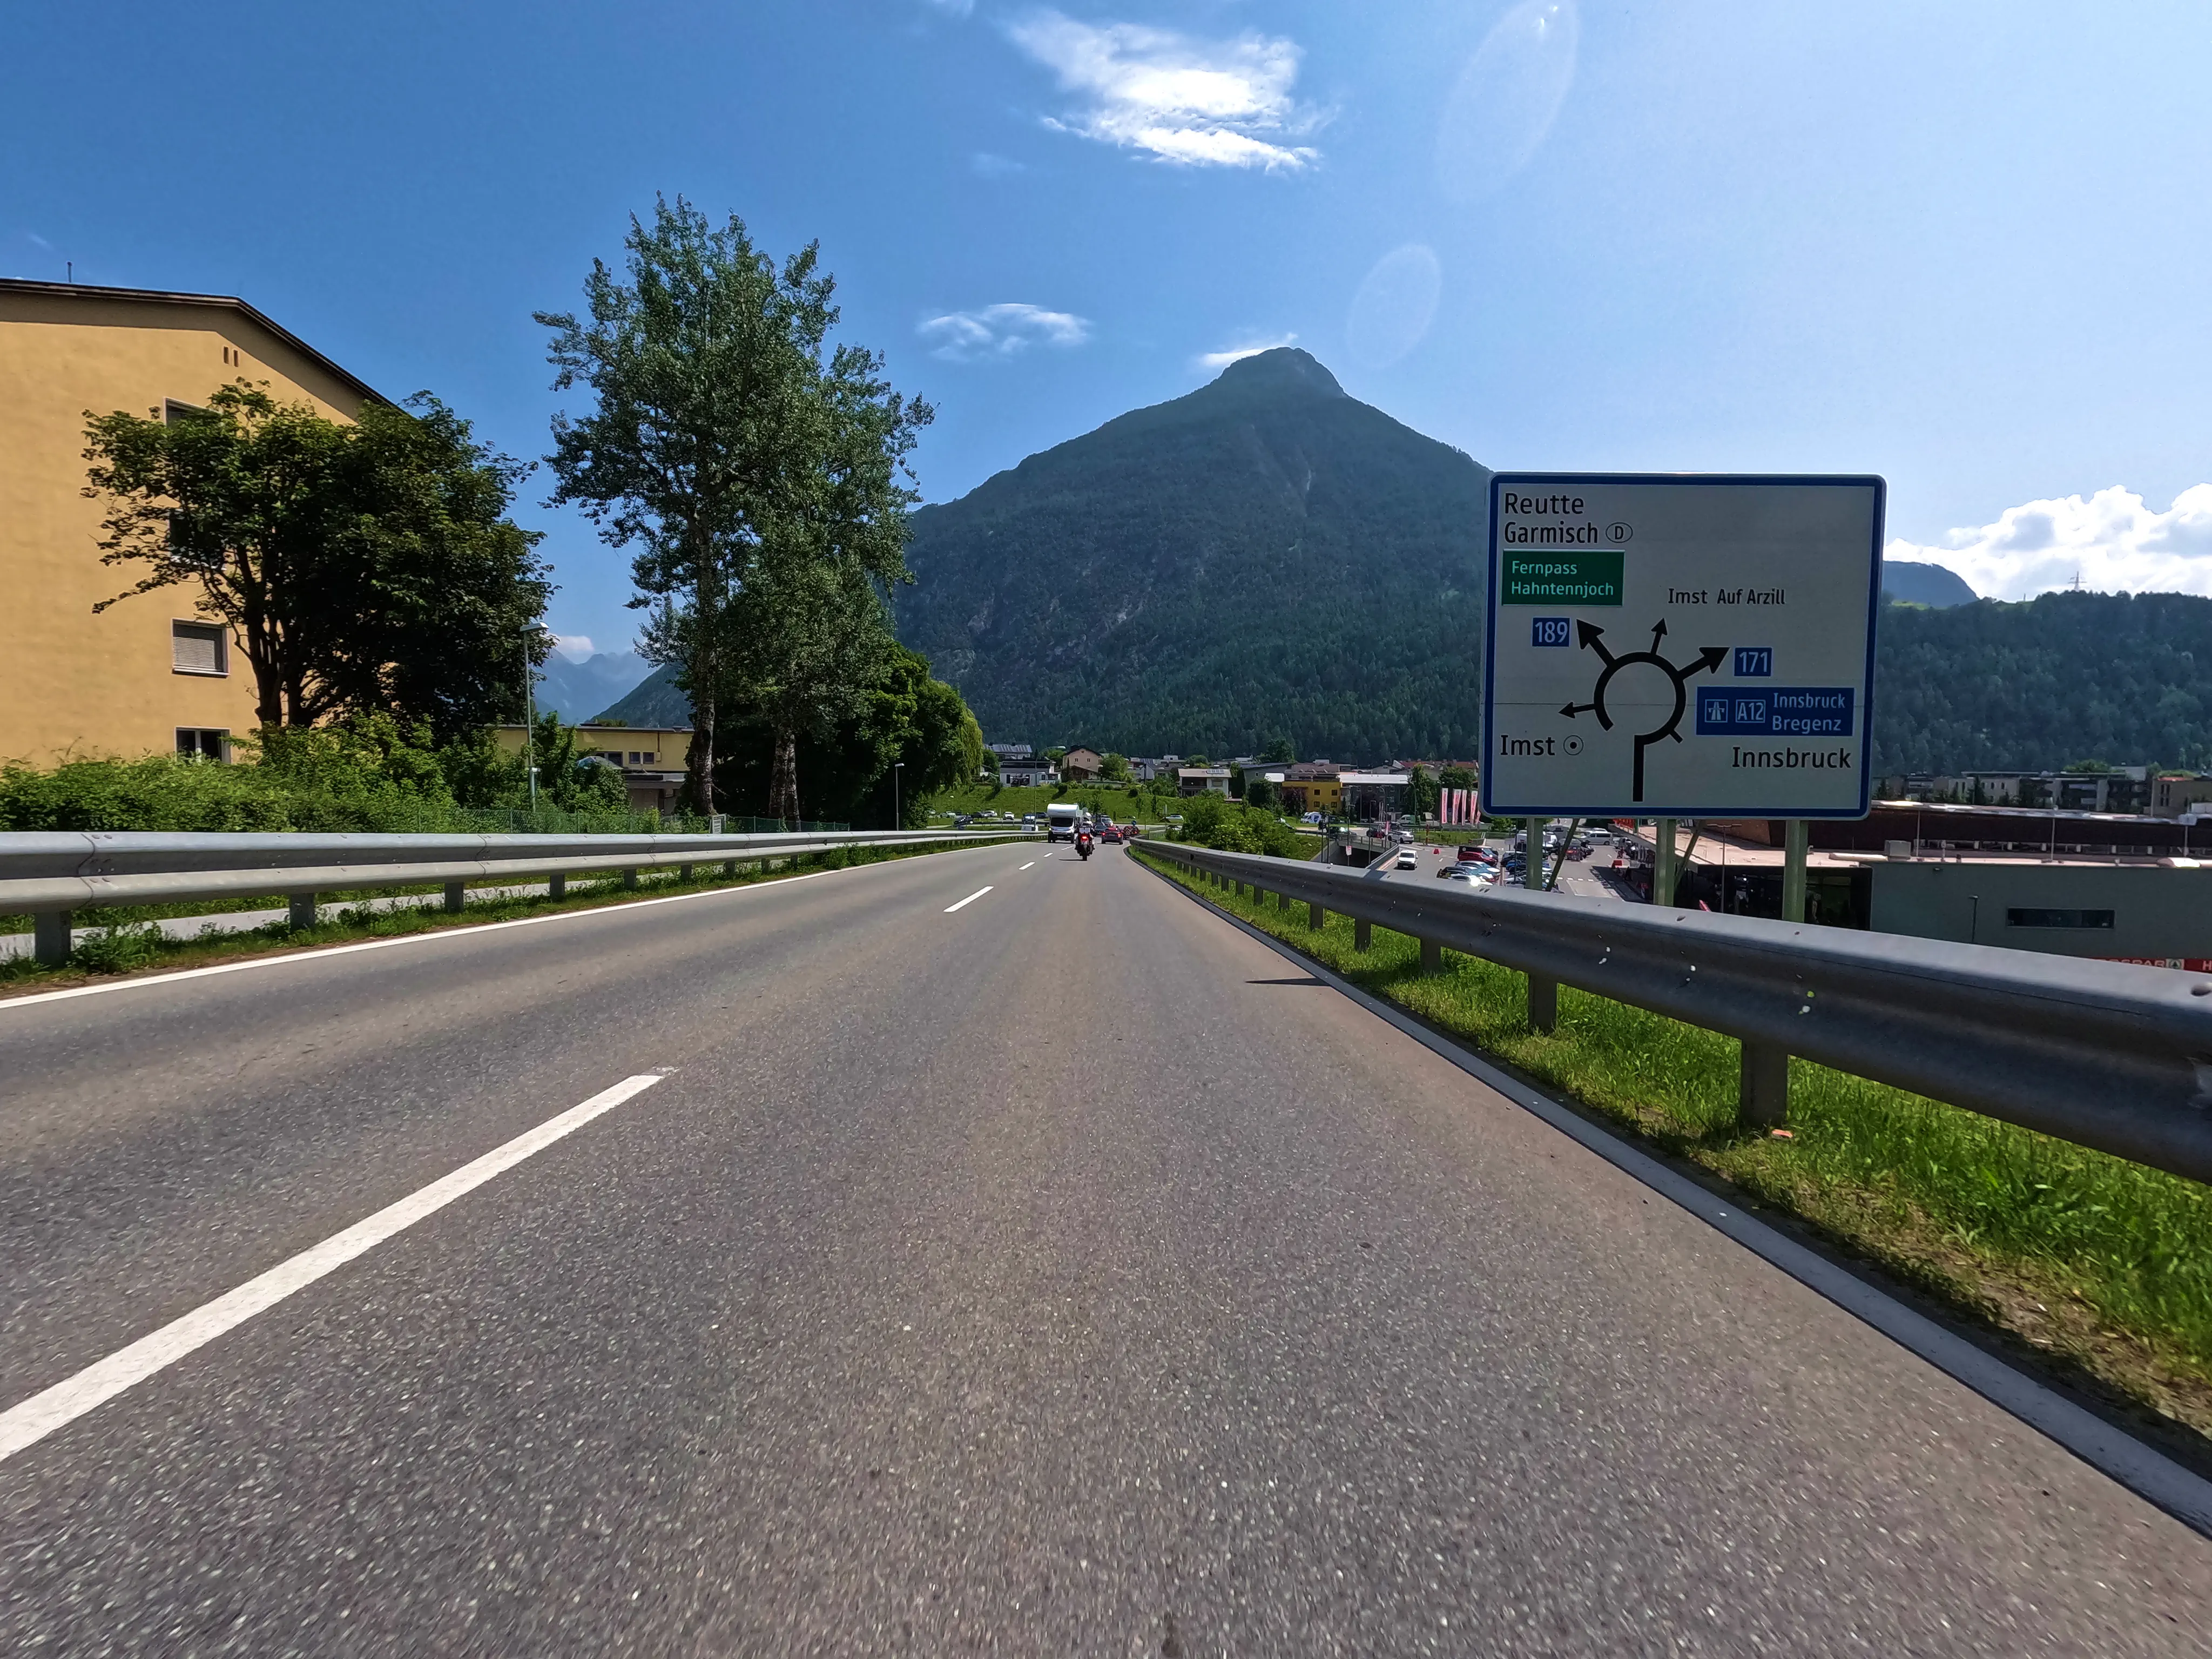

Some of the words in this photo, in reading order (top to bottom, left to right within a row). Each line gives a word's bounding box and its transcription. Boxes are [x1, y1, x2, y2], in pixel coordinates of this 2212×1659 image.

[1505, 493, 1584, 515] Reutte
[1505, 521, 1598, 543] Garmisch
[1614, 526, 1624, 540] D
[1512, 561, 1577, 577] Fernpass
[1512, 581, 1614, 598] Hahntennjoch
[1668, 588, 1708, 604] Imst
[1717, 589, 1744, 604] Auf
[1746, 588, 1785, 605] Arzill
[1535, 621, 1568, 643] 189
[1739, 651, 1768, 673] 171
[1773, 692, 1845, 708] Innsbruck
[1737, 702, 1764, 720] A12
[1772, 715, 1842, 734] Bregenz
[1500, 734, 1555, 756] Imst
[1732, 746, 1851, 768] Innsbruck
